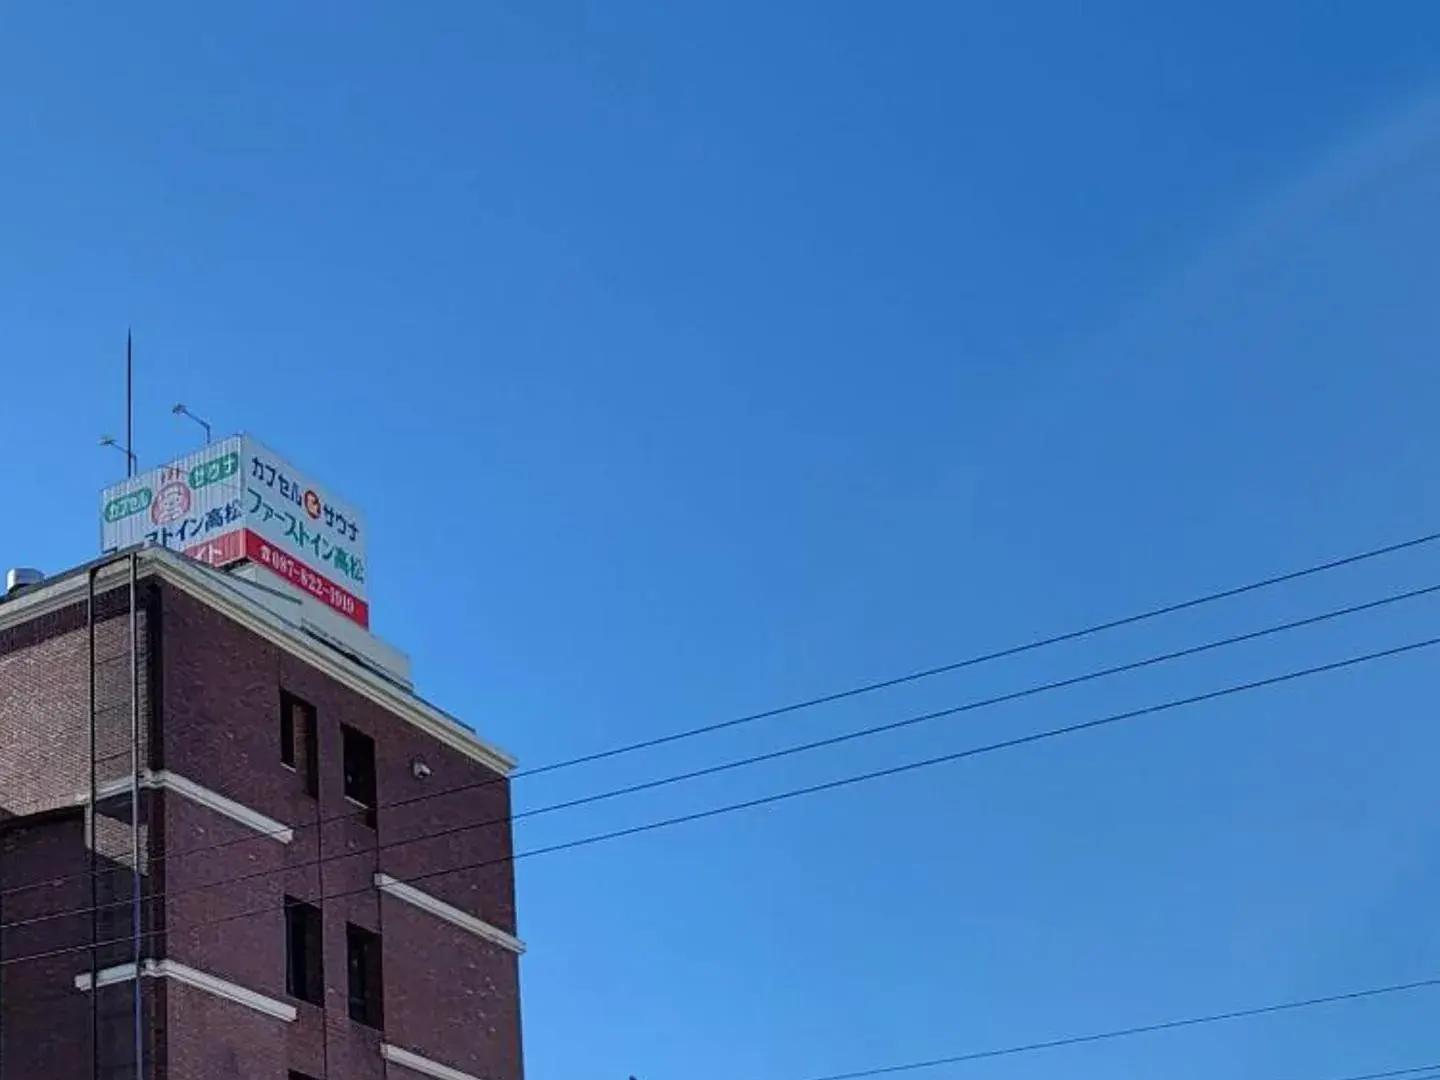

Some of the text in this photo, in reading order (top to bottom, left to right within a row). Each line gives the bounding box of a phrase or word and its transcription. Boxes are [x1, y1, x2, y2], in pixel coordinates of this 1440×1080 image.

[194, 456, 236, 486] サウナ
[108, 490, 149, 519] カプセル
[248, 487, 365, 583] ファーストイン高松
